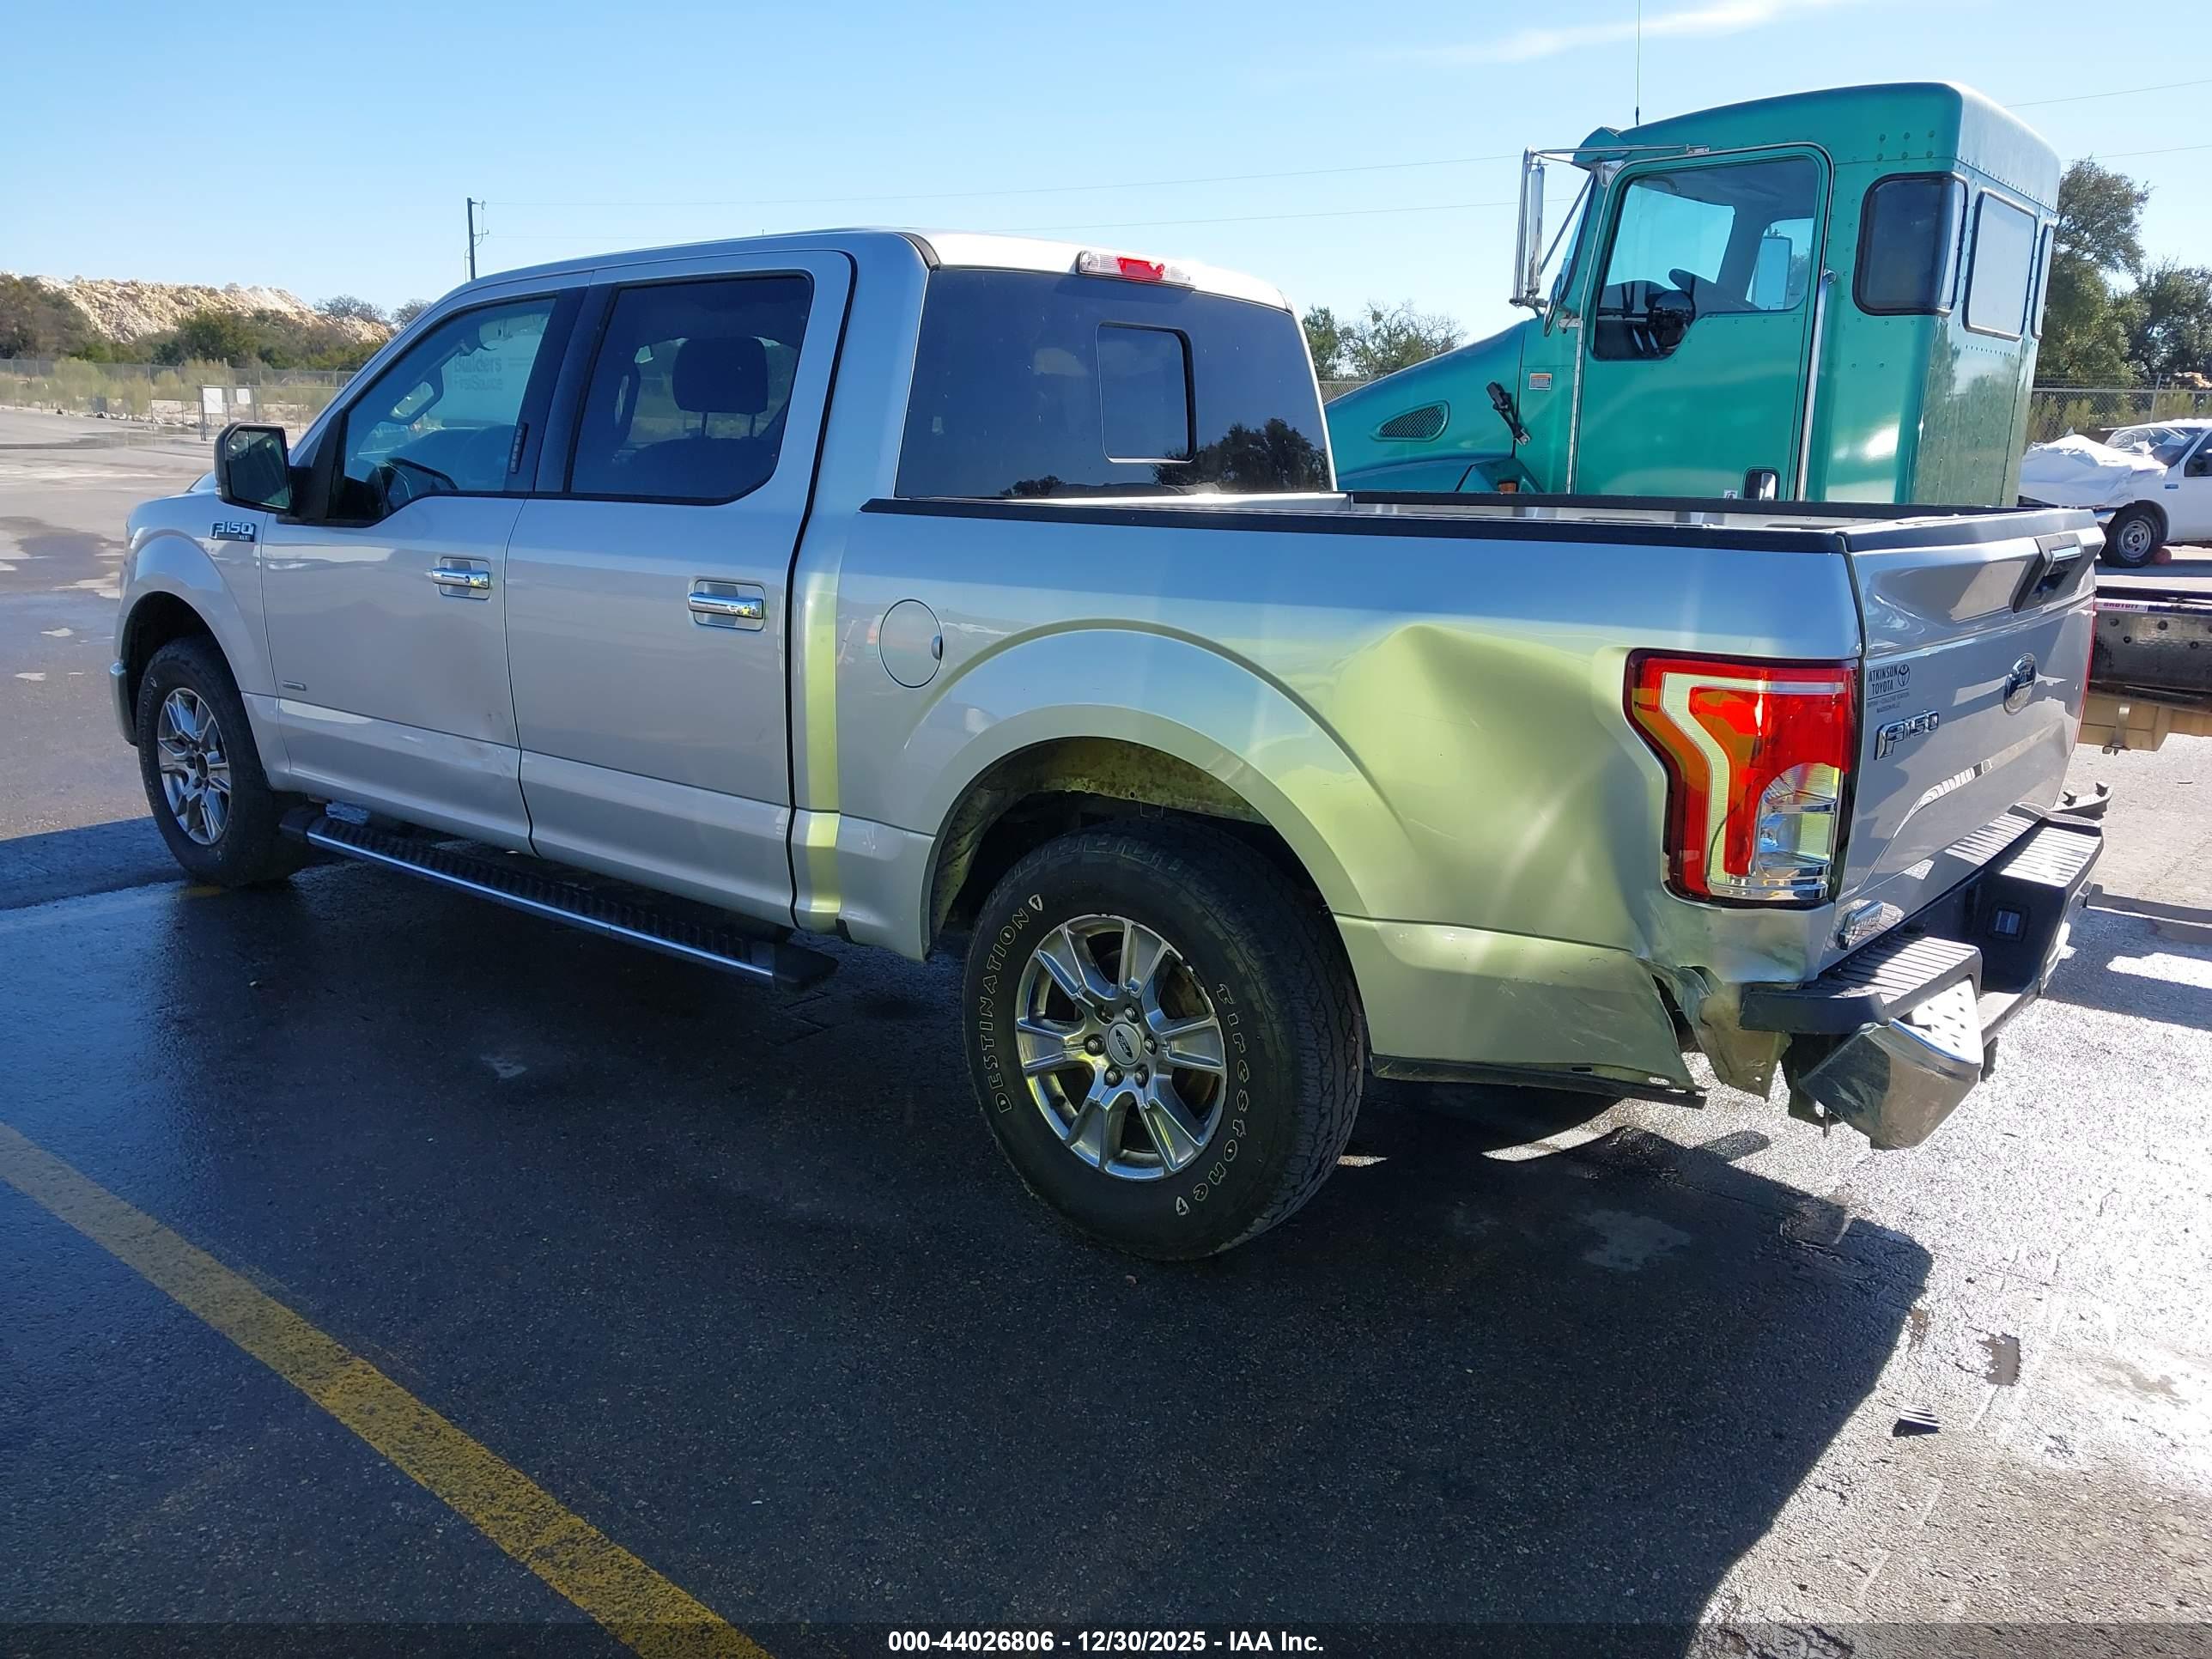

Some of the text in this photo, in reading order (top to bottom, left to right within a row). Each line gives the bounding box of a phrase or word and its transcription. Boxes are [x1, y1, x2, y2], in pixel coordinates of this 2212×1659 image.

[1869, 665, 1898, 682] ATKINSON
[1872, 679, 1894, 695] TOYOTA
[979, 907, 1030, 1114] DESTINATION
